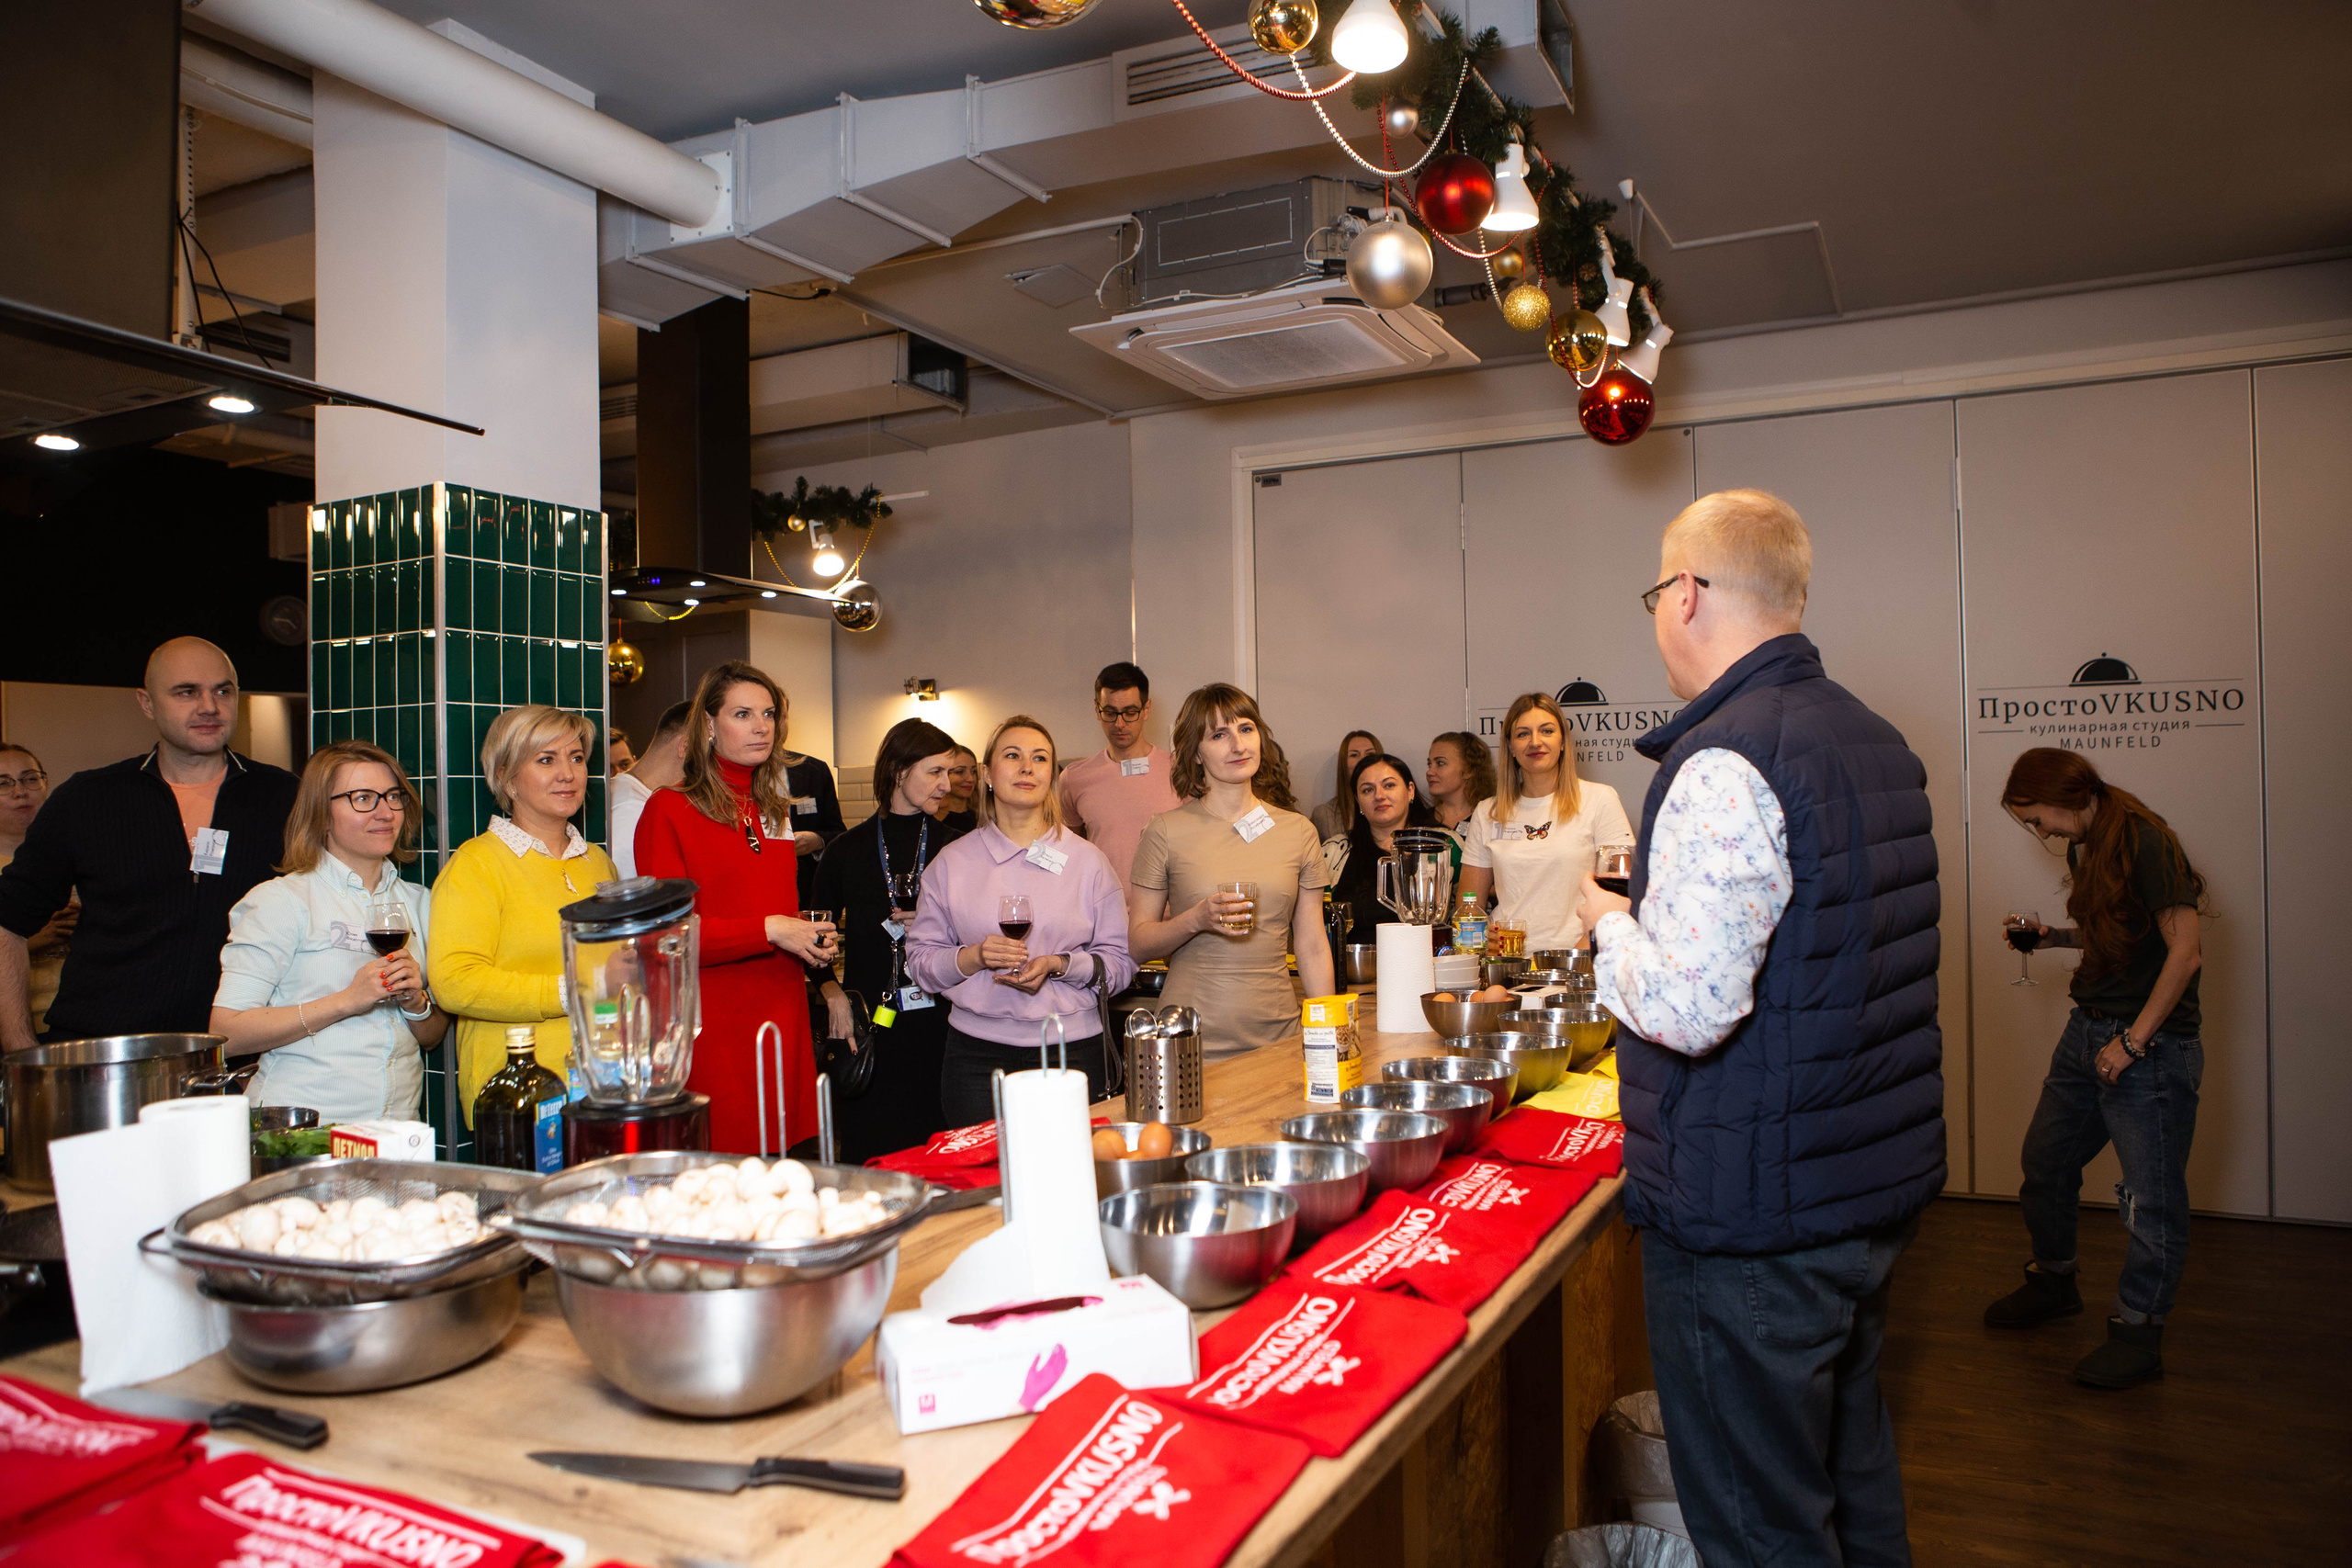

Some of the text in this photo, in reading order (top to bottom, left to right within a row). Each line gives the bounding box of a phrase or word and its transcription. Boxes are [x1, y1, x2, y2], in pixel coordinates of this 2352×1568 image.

[1978, 689, 2245, 724] ПростоVKUSNO
[2030, 720, 2190, 737] кулинарная студия
[2060, 736, 2162, 750] MAUNFELD
[1577, 750, 1624, 761] NFELD
